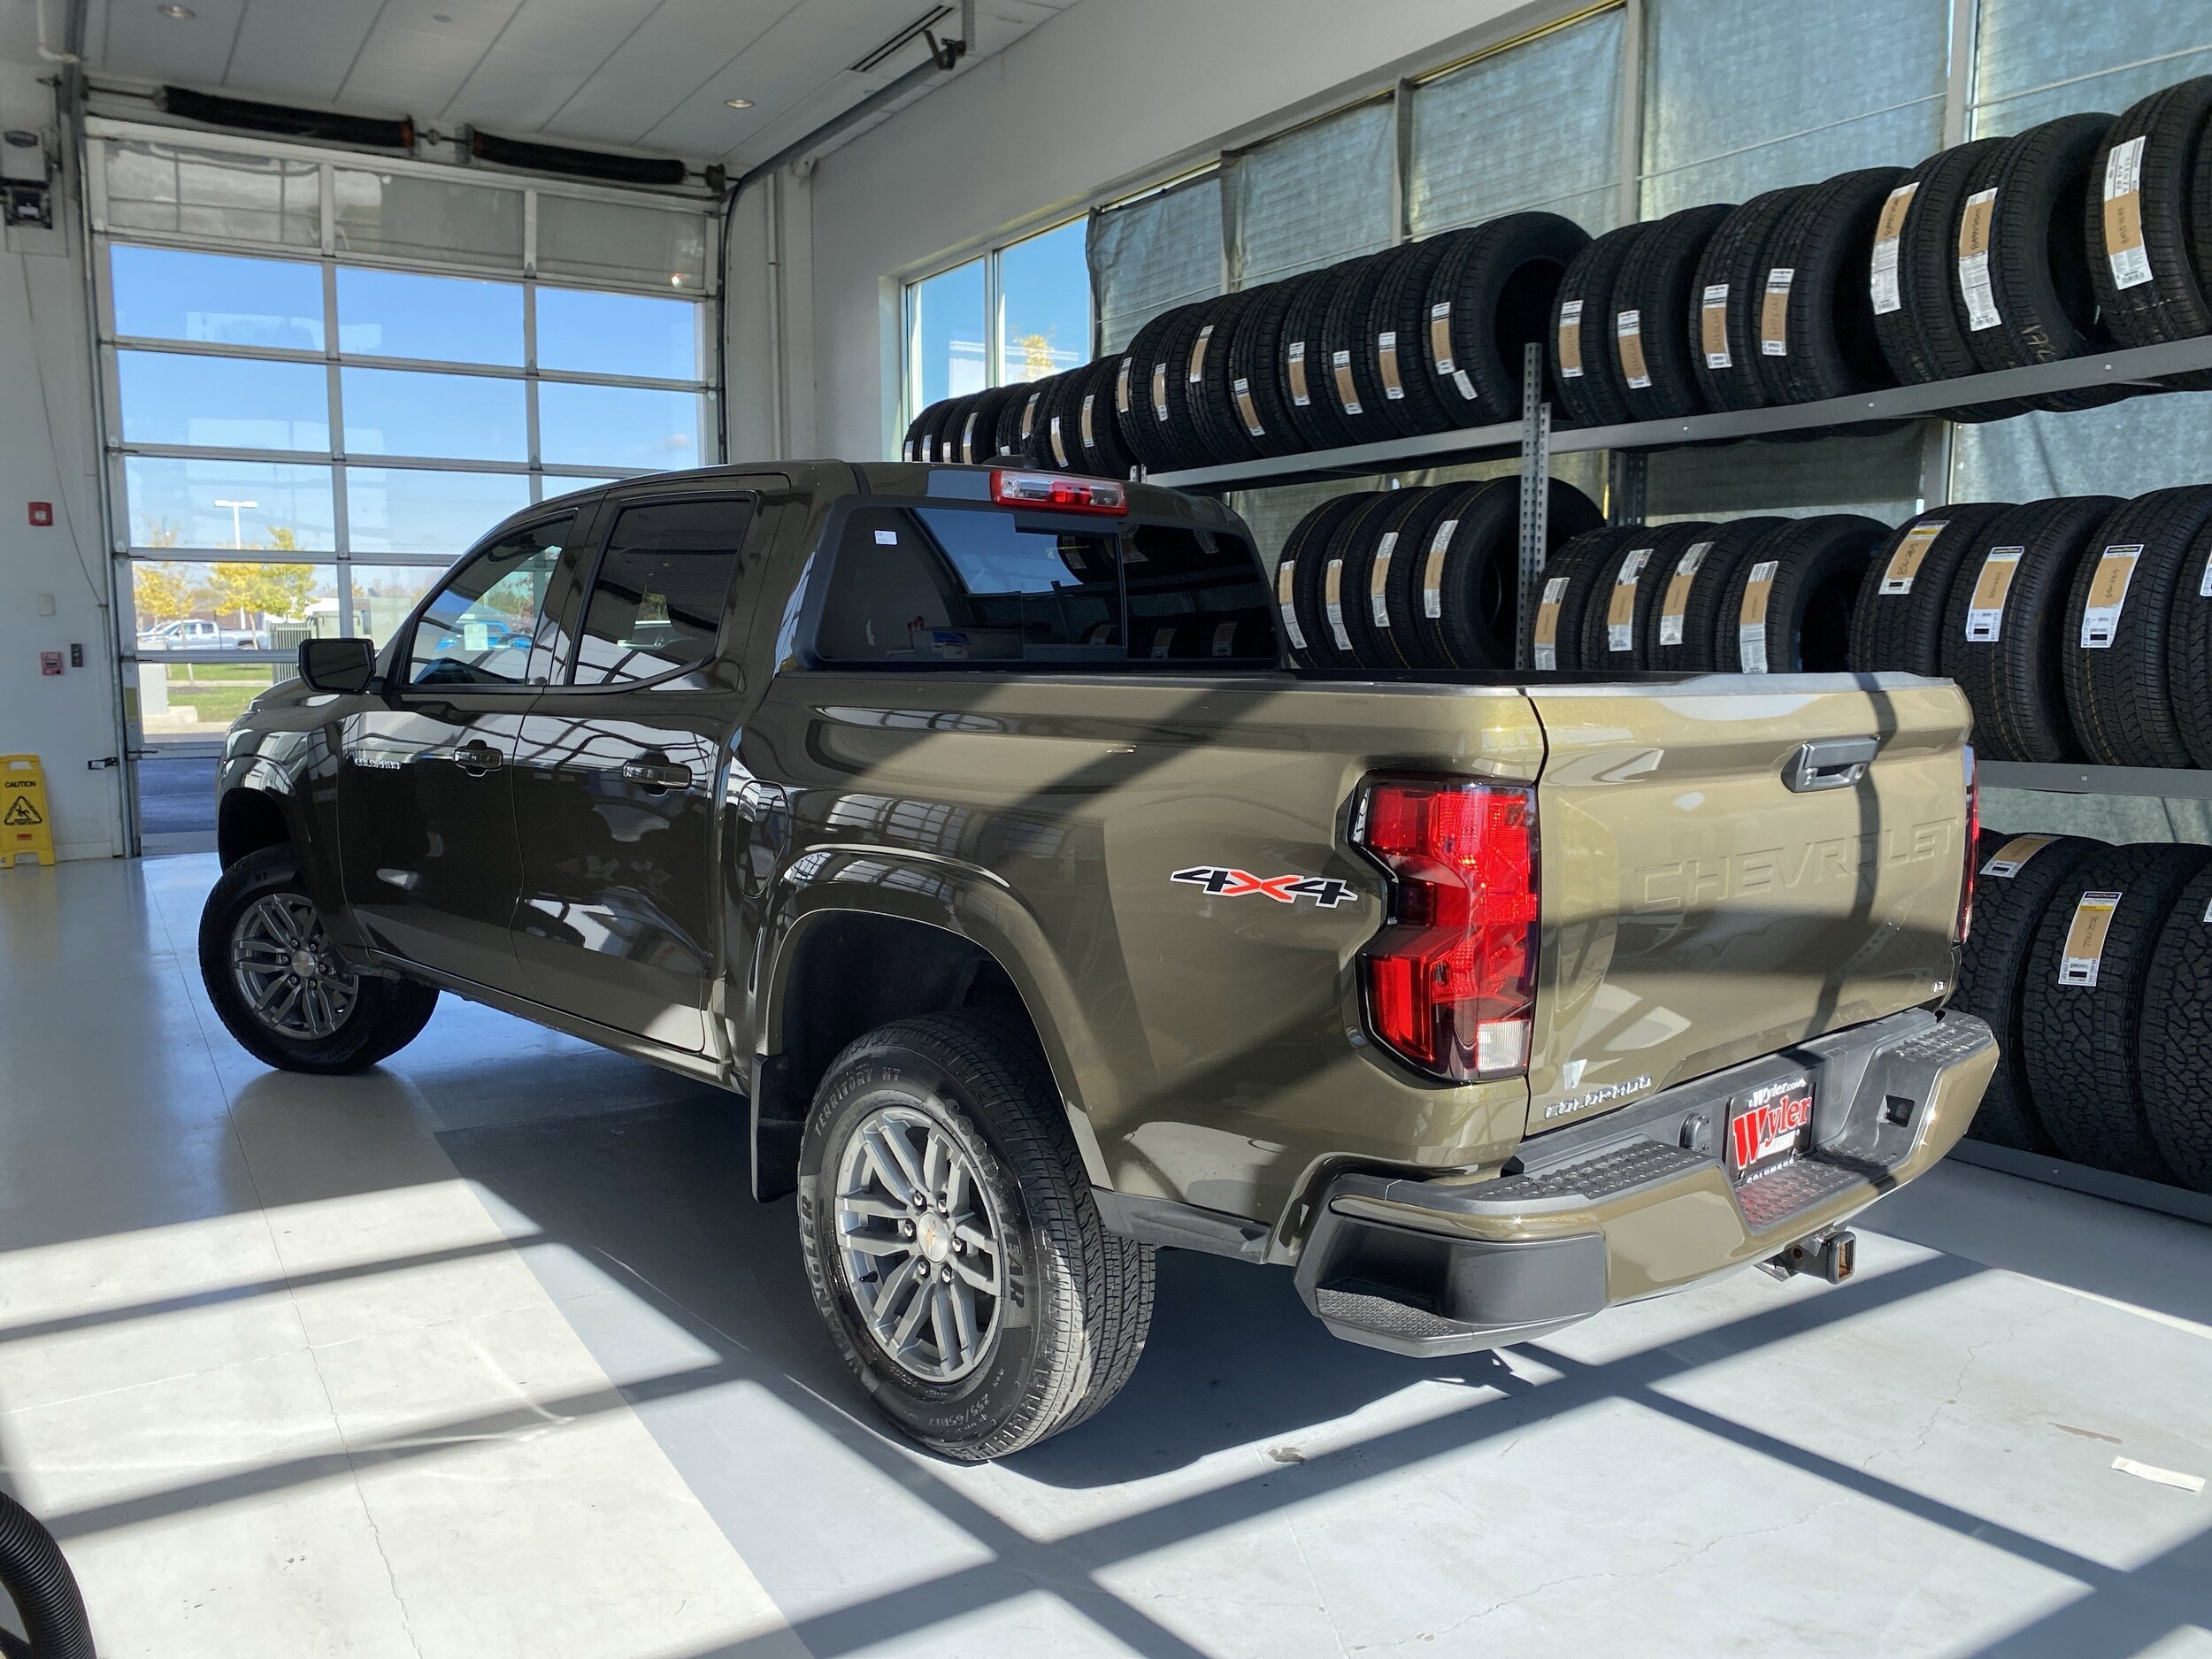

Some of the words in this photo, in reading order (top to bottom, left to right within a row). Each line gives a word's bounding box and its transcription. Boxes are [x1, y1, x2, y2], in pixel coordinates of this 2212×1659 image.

[1634, 816, 1959, 915] CHEVROLET
[813, 1067, 873, 1138] TERRITORY
[882, 1066, 902, 1082] HT
[1732, 1094, 1813, 1171] Wyler
[928, 1393, 990, 1428] 255/65R17
